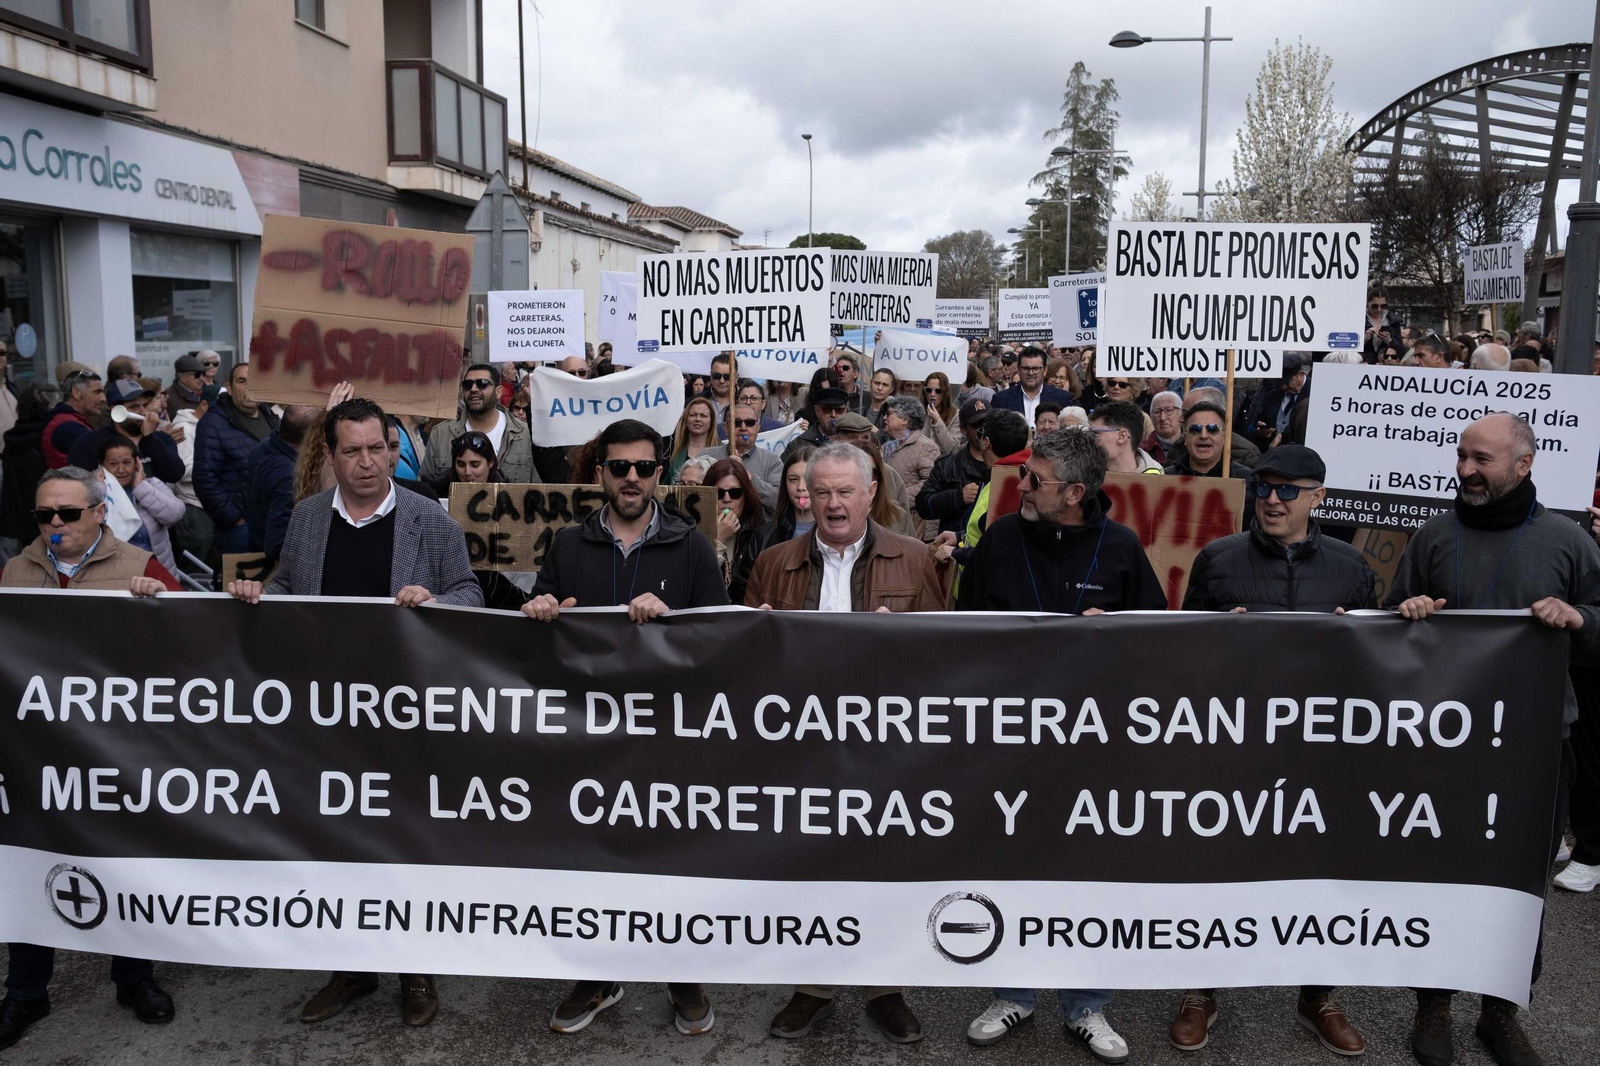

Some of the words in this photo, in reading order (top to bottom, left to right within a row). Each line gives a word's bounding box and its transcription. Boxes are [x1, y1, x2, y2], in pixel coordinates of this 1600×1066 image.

[22, 128, 142, 193] Corrales
[155, 178, 199, 204] CENTRO
[199, 186, 237, 211] DENTAL
[1115, 229, 1187, 278] BASTA
[1193, 231, 1223, 278] DE
[1227, 231, 1361, 280] PROMESAS
[1472, 247, 1499, 272] BASTA
[1501, 246, 1513, 270] DE
[643, 260, 670, 298] NO
[676, 258, 720, 297] MAS
[725, 253, 824, 294] MUERTOS
[830, 254, 858, 284] MOS
[860, 255, 885, 285] UNA
[887, 257, 933, 287] MIERDA
[1053, 277, 1098, 288] Carreteras
[610, 295, 618, 303] A
[1004, 293, 1028, 301] Cumplid
[1466, 275, 1522, 301] AISLAMIENTO
[507, 301, 566, 310] PROMETIERON
[837, 291, 911, 324] CARRETERAS
[972, 304, 985, 312] tajo
[1010, 312, 1024, 320] Esta
[1029, 302, 1039, 310] YA
[1151, 292, 1316, 344] INCUMPLIDAS
[507, 327, 526, 335] NOS
[527, 326, 565, 335] DEJARON
[509, 315, 564, 323] CARRETERAS,
[661, 309, 684, 346] EN
[690, 304, 805, 346] CARRETERA
[1025, 320, 1047, 328] esperar
[508, 340, 519, 348] EN
[737, 347, 818, 365] AUTOVÍA
[880, 346, 959, 363] AUTOVÍA
[1107, 346, 1210, 372] NUESTROS
[1215, 348, 1272, 373] HJOS
[1358, 374, 1489, 397] ANDALUCÍA
[1495, 381, 1552, 400] 2025
[549, 384, 669, 418] AUTOVÍA
[1330, 396, 1342, 412] 5
[1347, 397, 1405, 417] horas
[1410, 400, 1437, 419] de
[1443, 405, 1509, 421] coch
[1543, 409, 1579, 428] día
[1332, 423, 1378, 440] para
[1384, 425, 1462, 448] trabaja
[1387, 472, 1461, 493] BASTA
[1310, 508, 1356, 522] MEJORA
[1358, 513, 1374, 524] DE
[1376, 514, 1399, 526] LAS
[1389, 503, 1455, 517] URGENT
[465, 531, 515, 564] DE
[1081, 582, 1104, 591] Columbia
[16, 675, 292, 725] ARREGLO
[309, 680, 568, 735] URGENTE
[585, 691, 657, 736] DE
[674, 692, 738, 741] LA
[753, 692, 1109, 746] CARRETERA
[1126, 696, 1245, 746] SAN
[1265, 696, 1472, 748] PEDRO
[1491, 700, 1505, 748] !
[41, 765, 280, 816] MEJORA
[319, 770, 391, 818] DE
[428, 774, 532, 822] LAS
[568, 778, 955, 838] CARRETERAS
[993, 789, 1029, 836] Y
[1064, 777, 1327, 838] AUTOVÍA
[1368, 791, 1442, 839] YA
[1485, 792, 1499, 840] !
[117, 889, 343, 930] INVERSIÓN
[357, 898, 411, 932] EN
[425, 900, 861, 947] INFRAESTRUCTURAS
[1019, 916, 1258, 950] PROMESAS
[1270, 908, 1431, 949] VACÍAS
